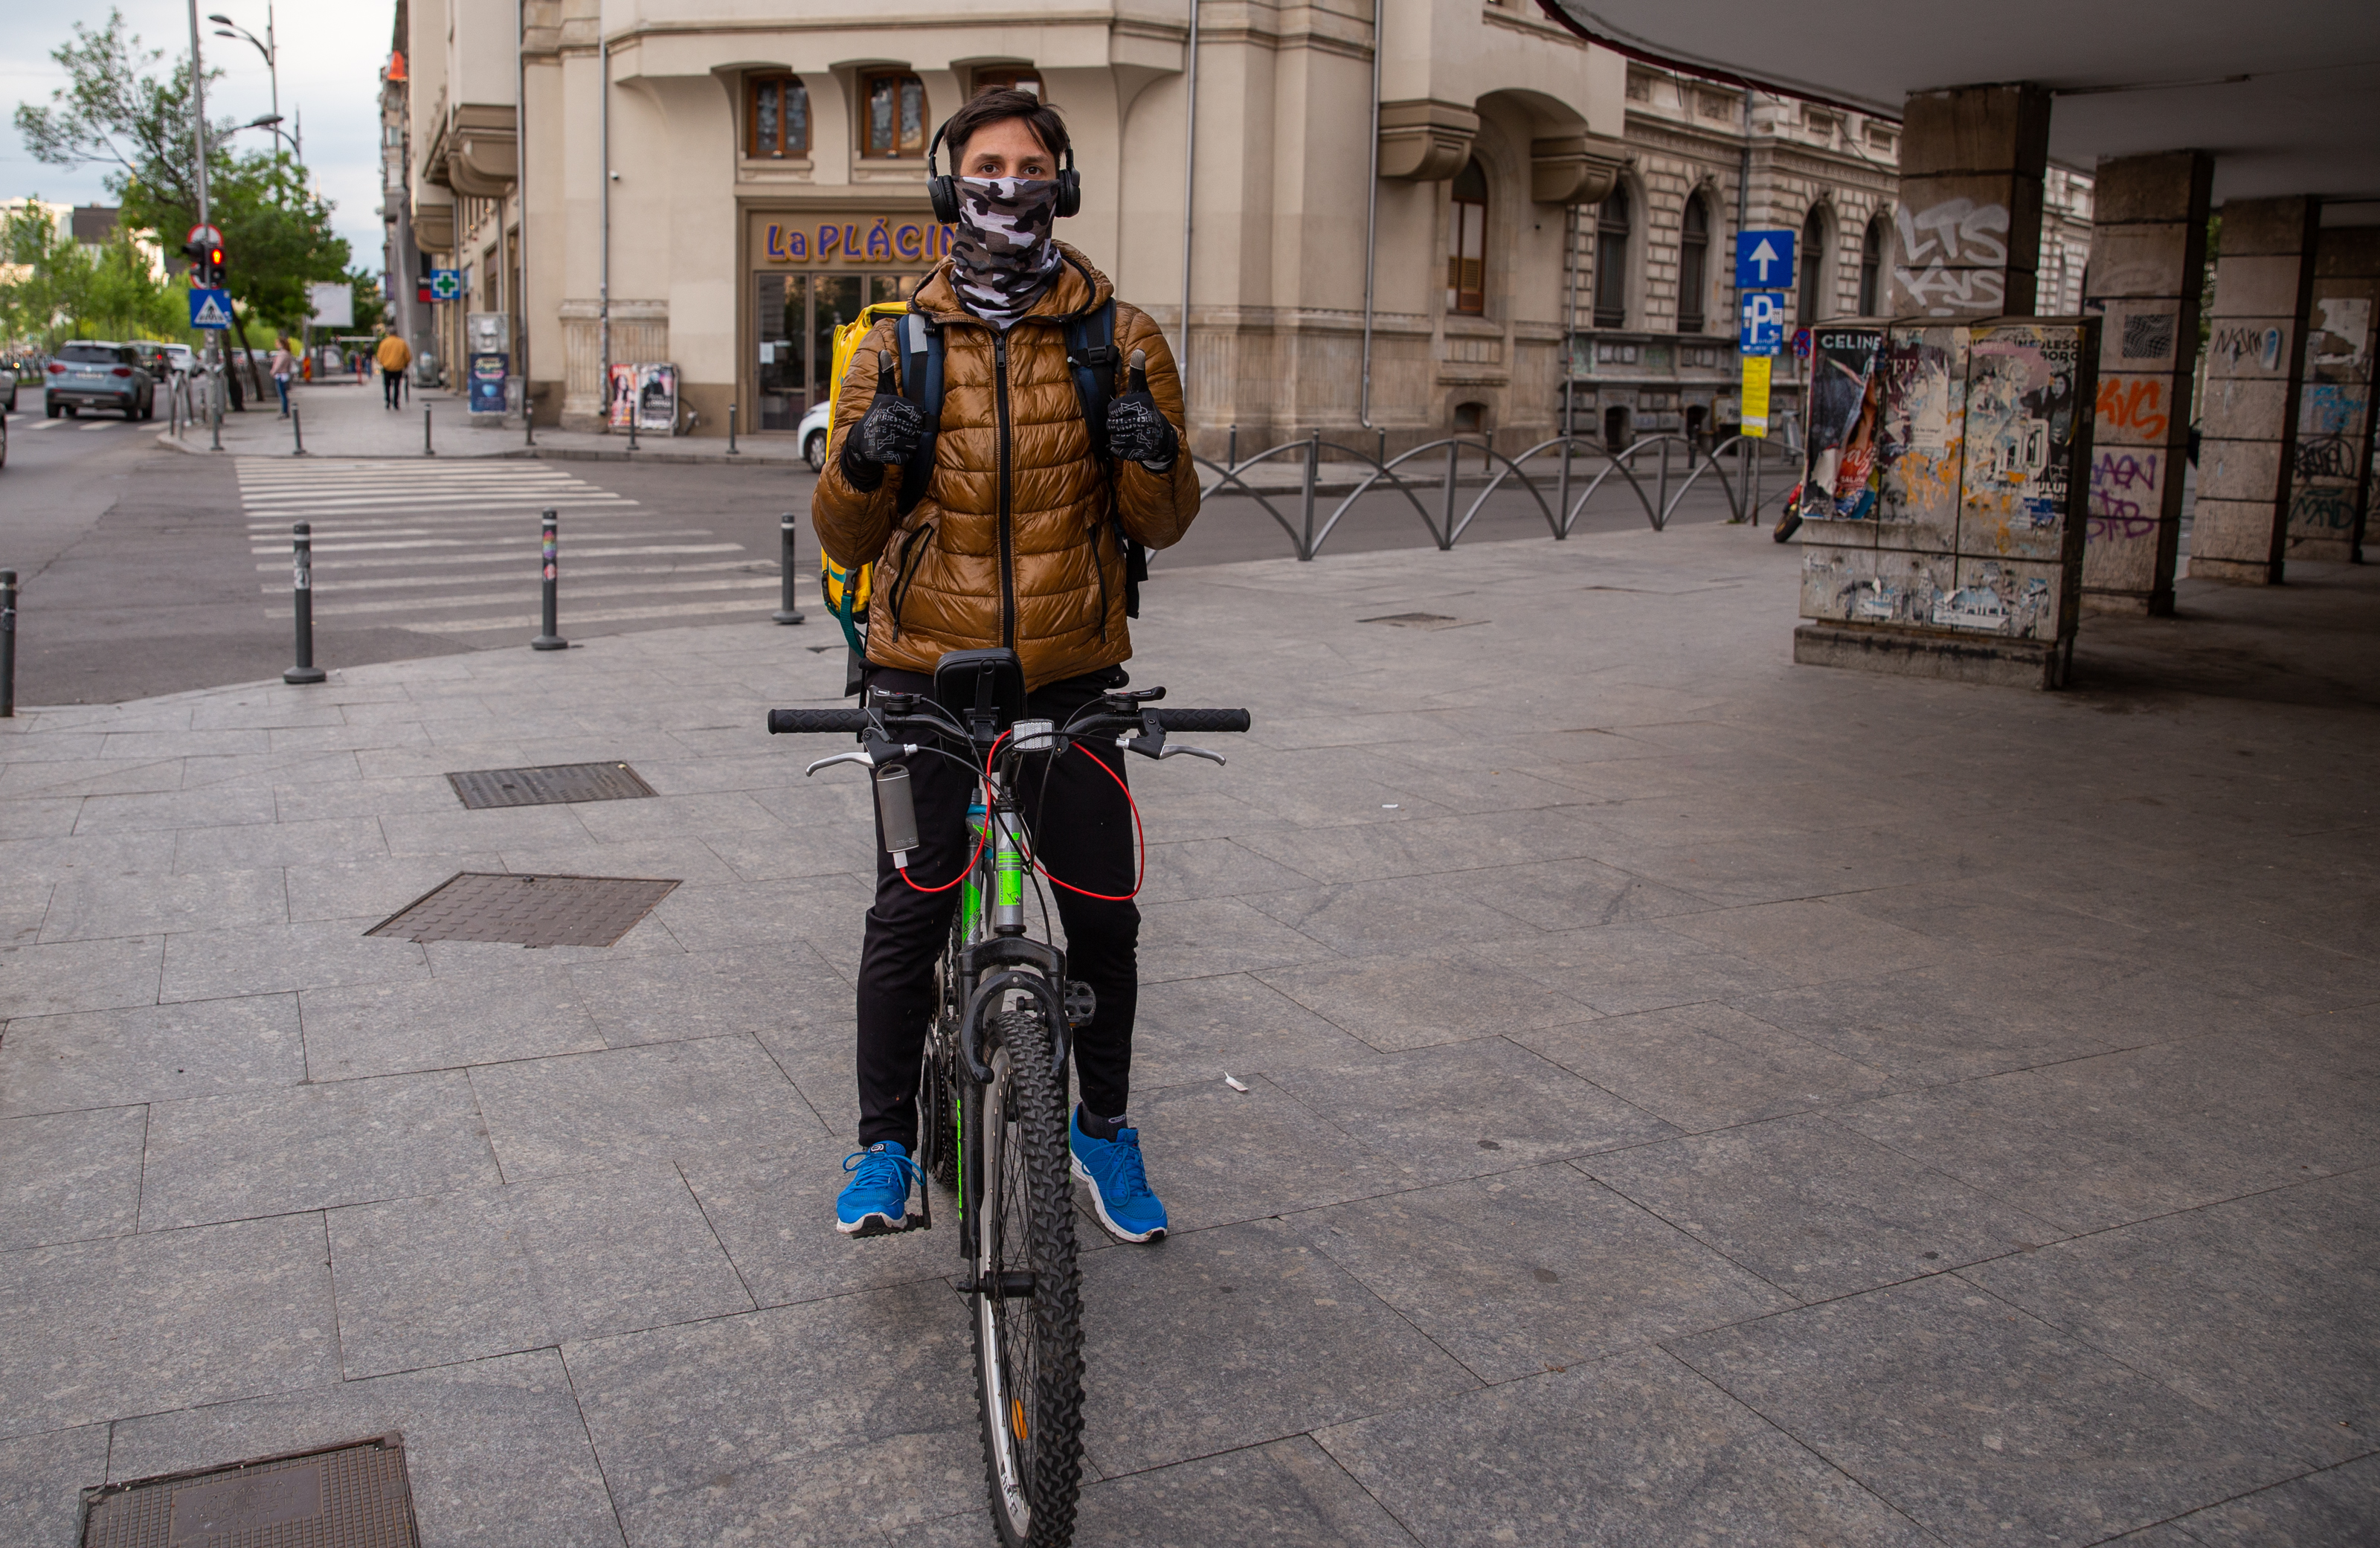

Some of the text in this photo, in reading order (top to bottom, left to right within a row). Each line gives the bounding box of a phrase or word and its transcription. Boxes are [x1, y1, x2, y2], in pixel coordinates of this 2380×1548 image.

[765, 222, 809, 262] La
[1821, 334, 1881, 351] CELINE
[963, 907, 980, 934] SERIES
[194, 1486, 298, 1514] MUNICIPIULUI
[206, 1480, 286, 1501] PRIMARIA
[199, 1494, 294, 1521] BUCURESTI
